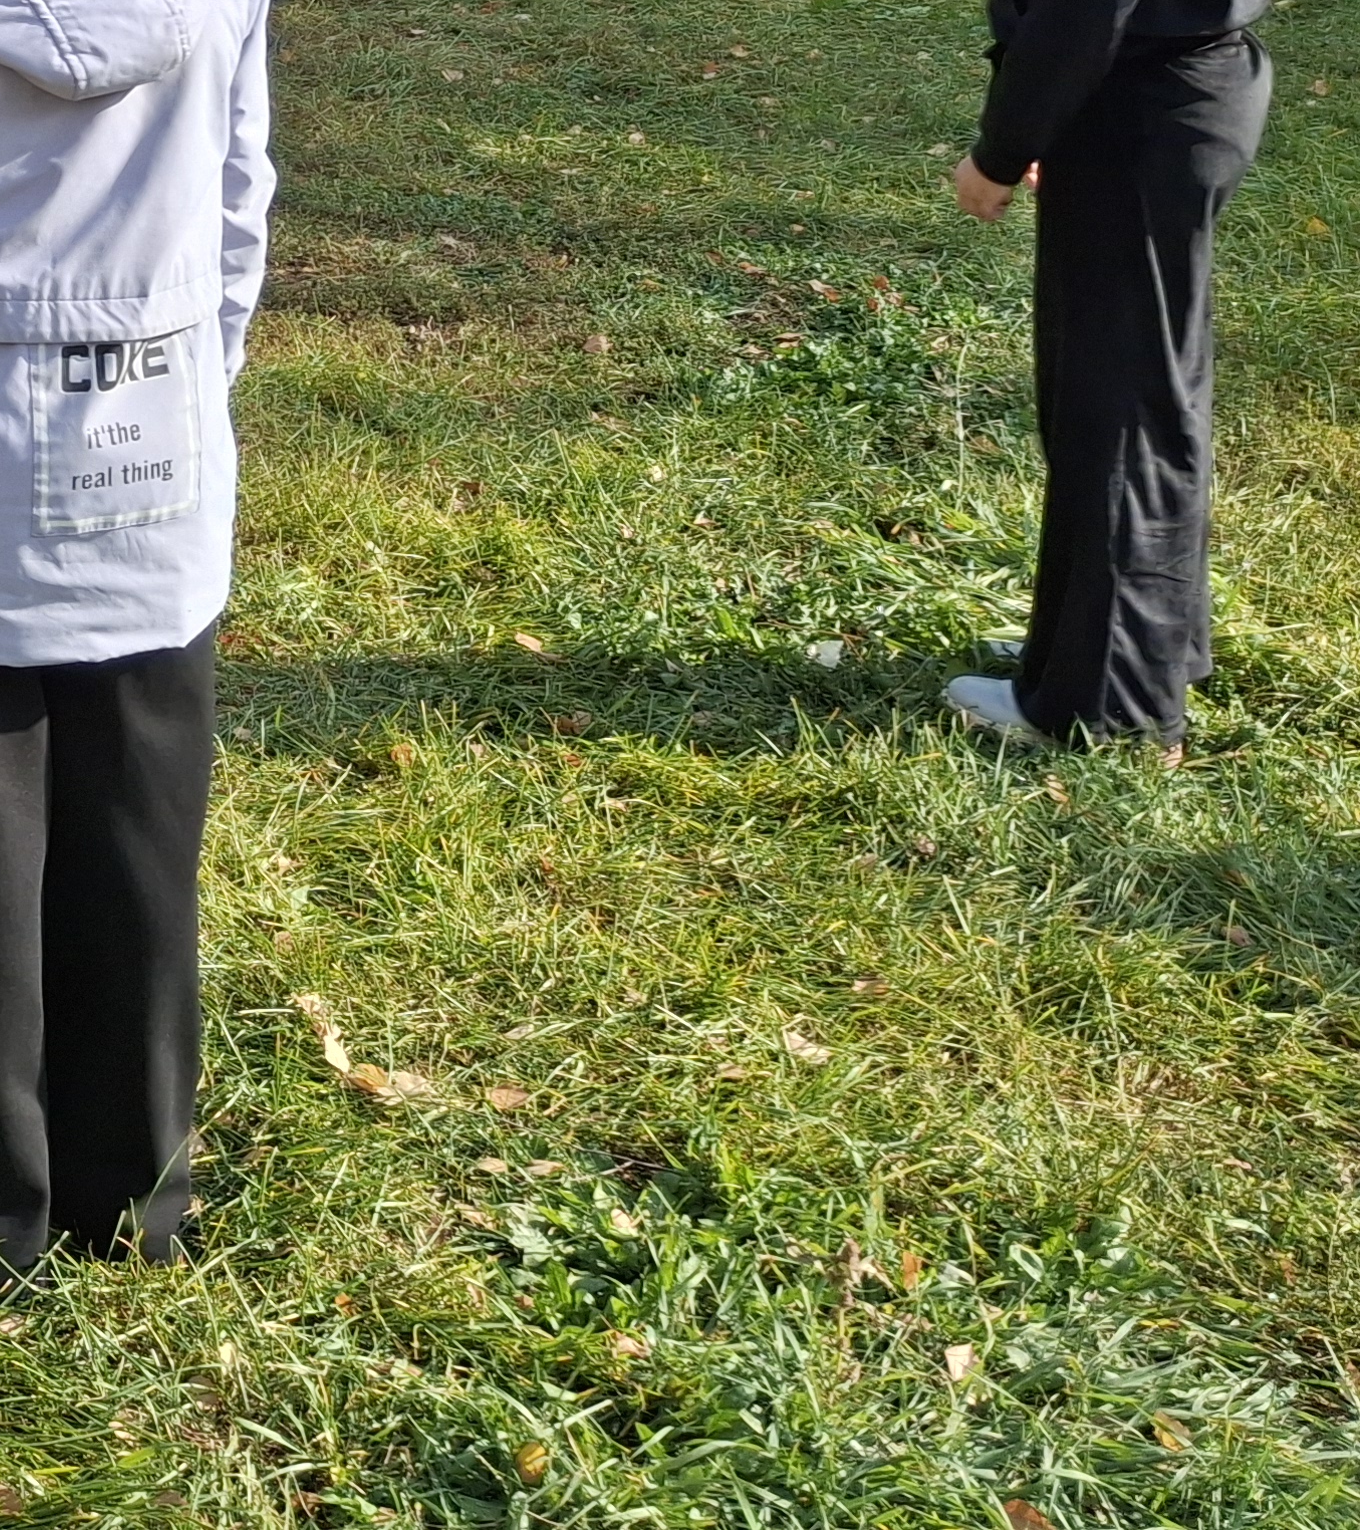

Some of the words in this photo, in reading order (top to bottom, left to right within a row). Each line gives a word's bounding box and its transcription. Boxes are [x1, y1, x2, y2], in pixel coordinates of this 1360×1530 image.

[62, 341, 170, 392] COKE
[72, 467, 112, 491] real
[122, 460, 173, 485] thing
